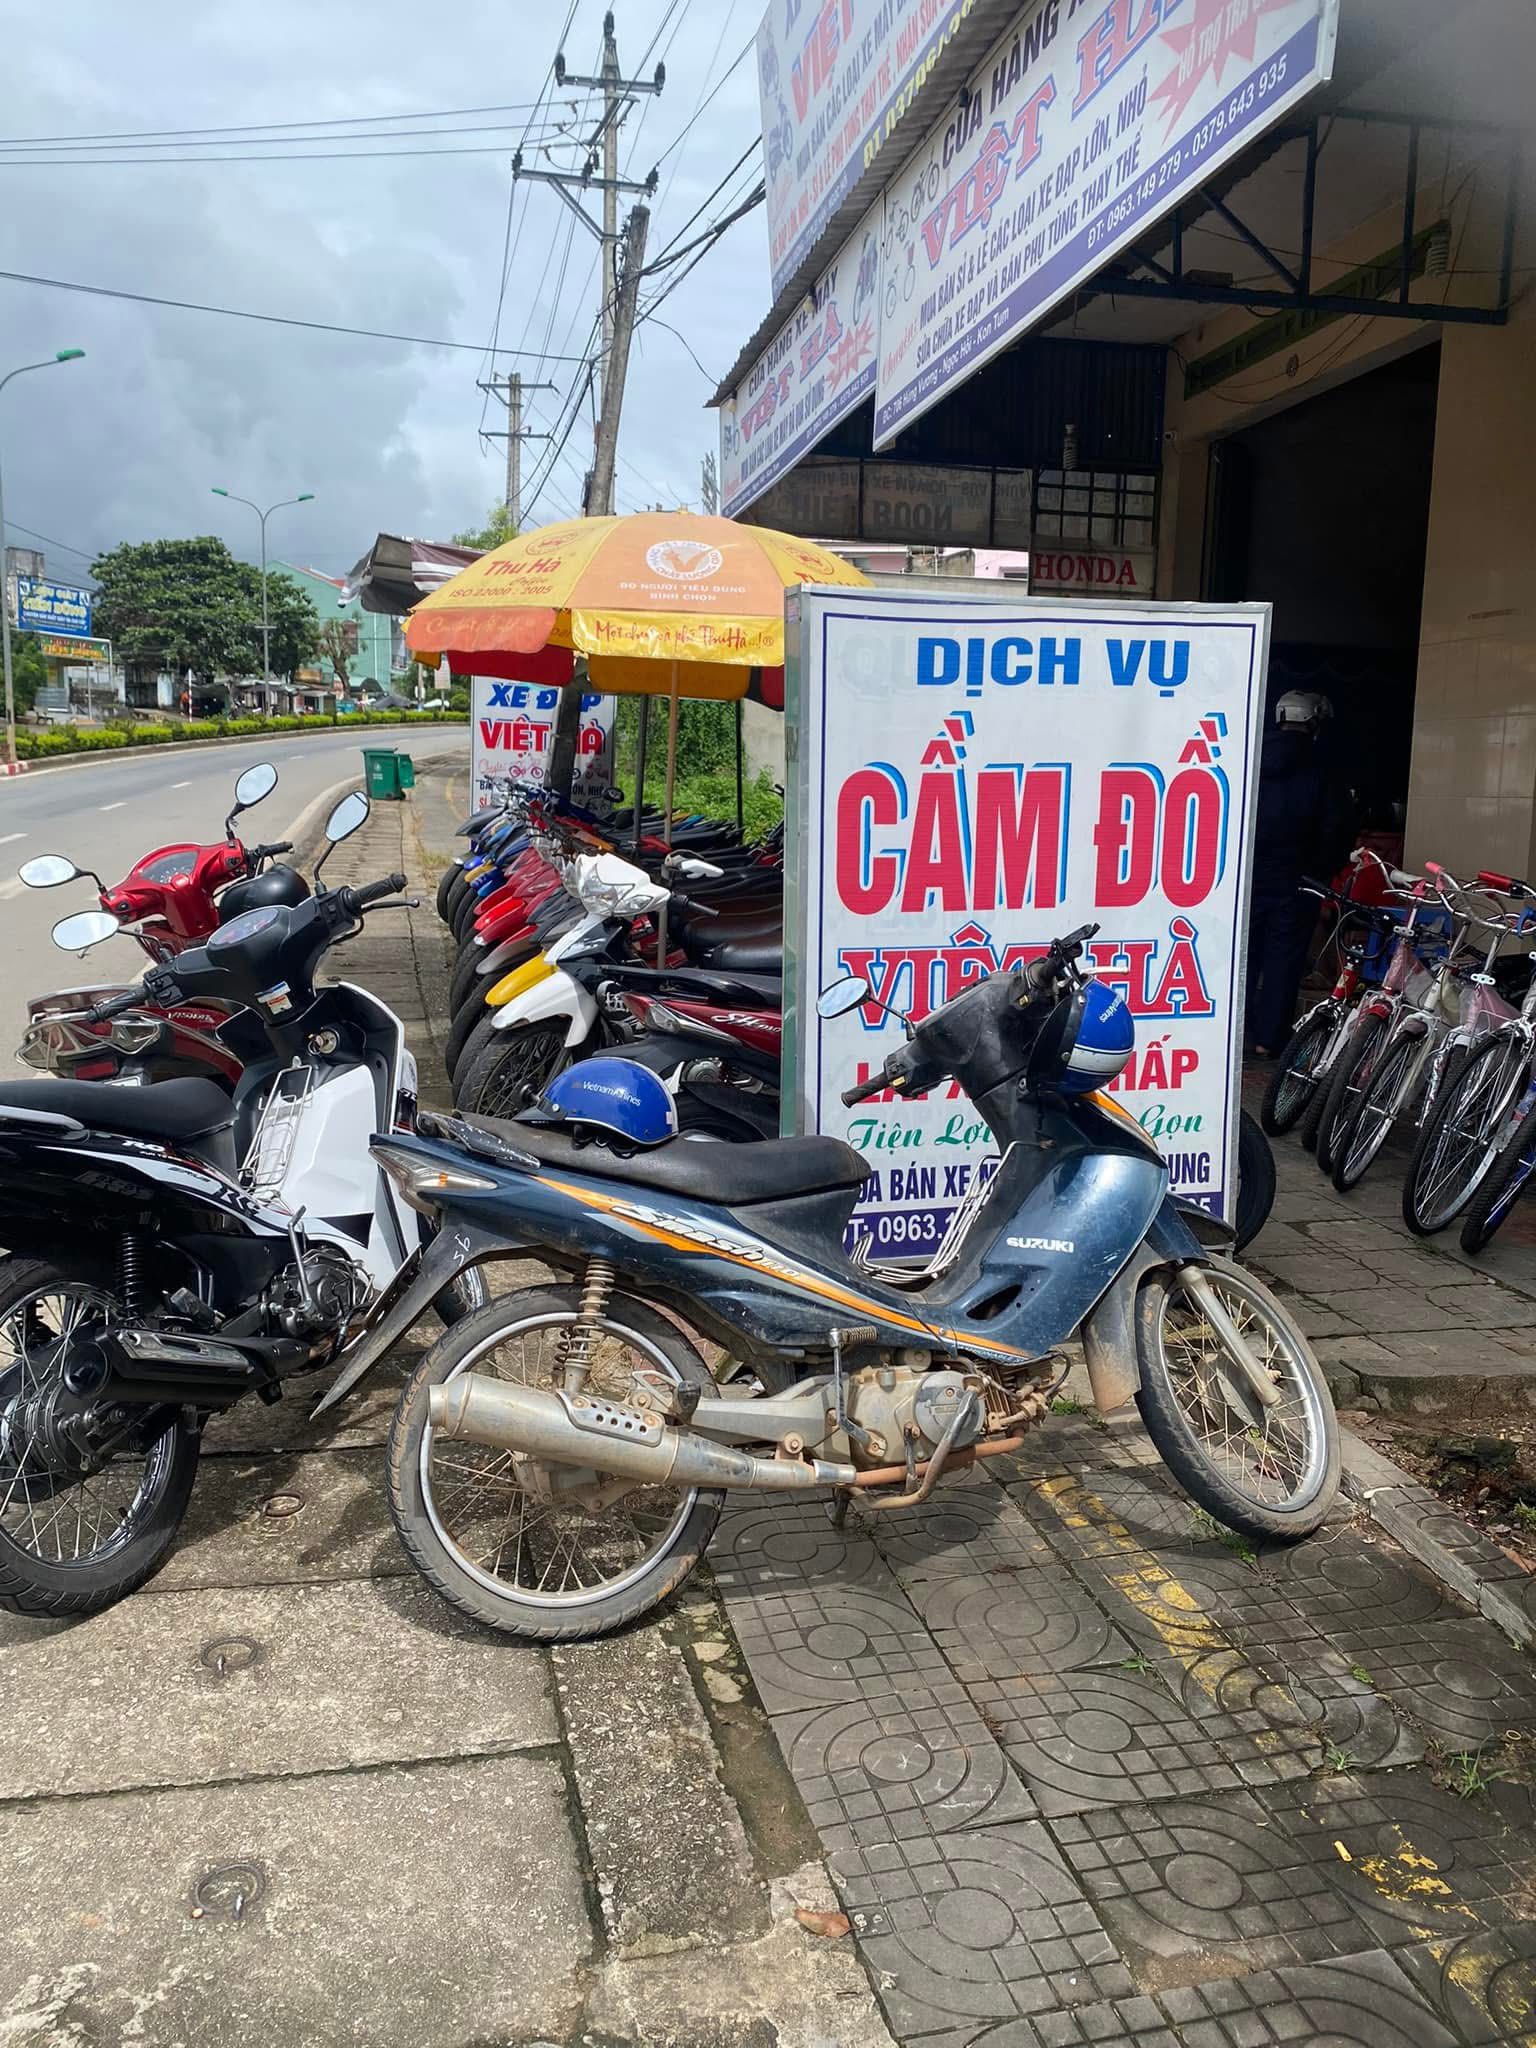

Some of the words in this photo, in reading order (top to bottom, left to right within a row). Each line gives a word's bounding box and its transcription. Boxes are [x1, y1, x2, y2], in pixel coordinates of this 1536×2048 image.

[991, 2, 1059, 114] HÀNG
[921, 73, 1057, 271] VIỆT
[1087, 222, 1106, 249] ĐT:
[1107, 176, 1157, 234] 0963.149
[1158, 151, 1182, 190] 279
[1192, 81, 1255, 157] 0379.643
[1258, 53, 1288, 98] 935
[920, 291, 936, 330] MUA
[937, 270, 955, 312] BÁN
[957, 251, 966, 293] SỈ
[967, 253, 975, 283] &
[977, 230, 988, 274] LẺ
[991, 217, 1010, 261] CÁC
[1012, 189, 1036, 240] LOẠI
[1037, 173, 1051, 215] XE
[1055, 145, 1079, 197] ĐẠP
[1081, 114, 1111, 171] LỚN,
[1116, 62, 1149, 138] NHỎ
[933, 316, 952, 354] CHỮA
[954, 304, 965, 335] XE
[968, 286, 983, 322] ĐẠP
[986, 269, 1000, 304] VÀ
[1001, 250, 1021, 293] BÁN
[1024, 228, 1047, 273] PHỤ
[1047, 198, 1076, 250] TÙNG
[1078, 163, 1112, 219] THAY
[1114, 123, 1142, 188] THẾ
[767, 327, 793, 376] HÀNG
[795, 313, 809, 343] XE
[977, 319, 993, 345] Kon
[993, 306, 1008, 329] Tum
[740, 360, 795, 443] VIỆT
[484, 560, 526, 577] Thu
[526, 556, 563, 575] Hà
[1034, 553, 1138, 587] HONDA
[917, 637, 1082, 698] DỊCH
[1105, 638, 1191, 698] VỤ
[487, 684, 530, 709] XE
[536, 688, 602, 713] ĐP
[479, 713, 553, 758] VIỆT
[836, 711, 1072, 916] CẦM
[1093, 711, 1230, 909] ĐỒ
[1086, 915, 1216, 1020] HÀ
[1107, 1034, 1200, 1091] HẤP
[847, 1118, 925, 1156] Tiện
[1139, 1104, 1205, 1140] Gọn
[889, 1160, 937, 1201] BÁN
[942, 1164, 972, 1199] XE
[1166, 1151, 1211, 1192] ỤNG
[611, 1204, 765, 1262] Smash
[1006, 1236, 1075, 1253] SUZUKI
